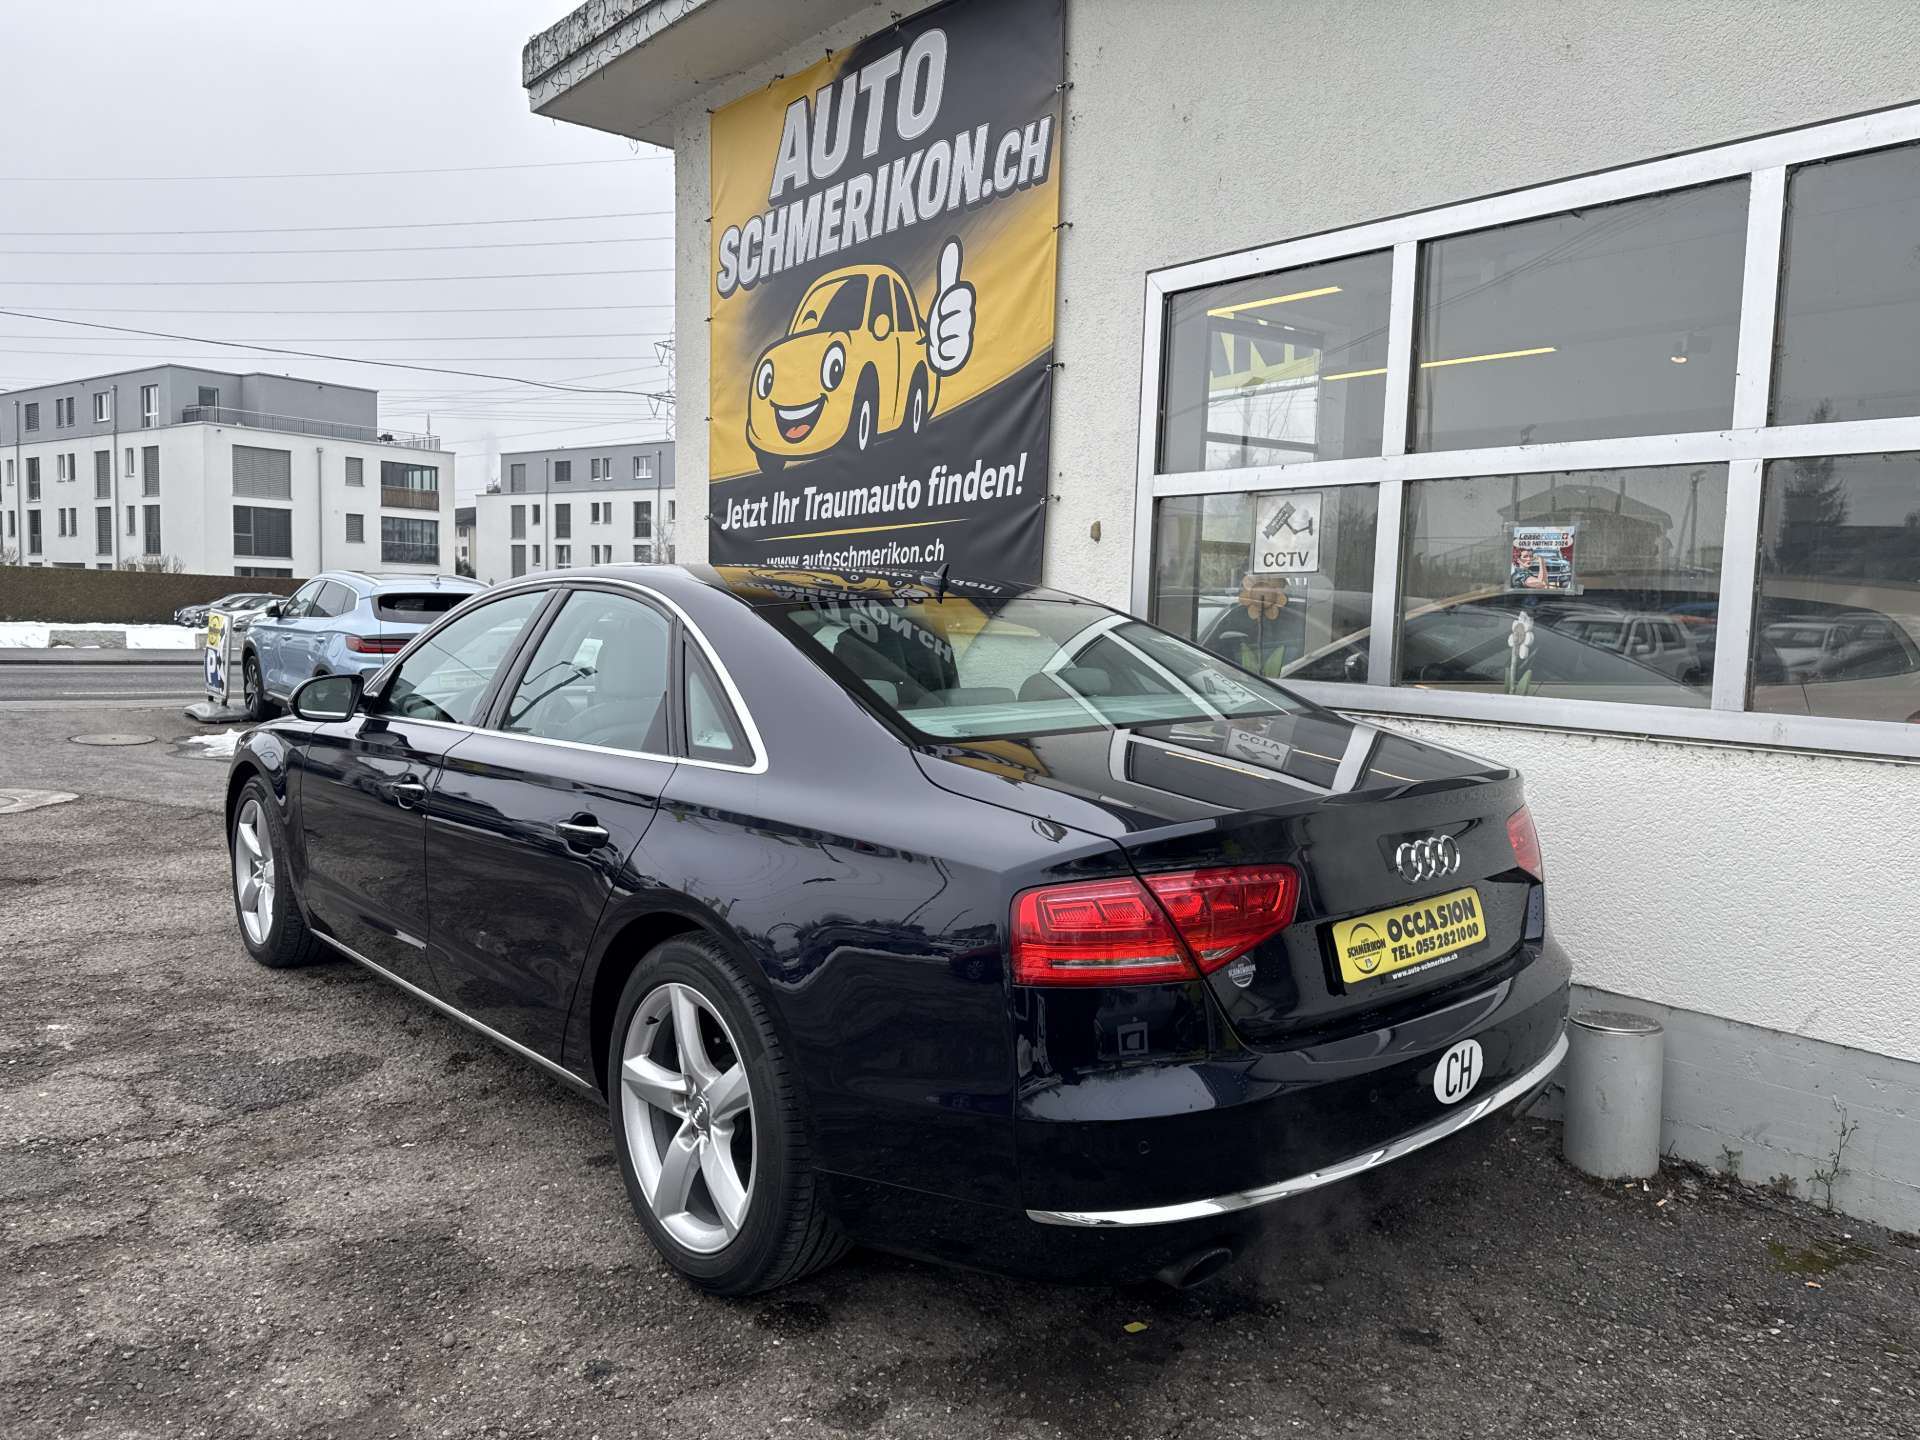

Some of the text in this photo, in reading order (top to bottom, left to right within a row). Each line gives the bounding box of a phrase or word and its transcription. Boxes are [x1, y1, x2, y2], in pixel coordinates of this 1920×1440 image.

[769, 28, 947, 199] AUTO
[717, 117, 1051, 292] SCHMERIKON.CH
[721, 453, 1027, 530] Jetzt Ihr Traumauto finden!
[766, 538, 944, 567] wwwautoschmerikon.ch
[1264, 551, 1309, 567] CCTV
[1387, 896, 1476, 942] OCCASION
[1391, 944, 1415, 962] TEL:
[1445, 1045, 1474, 1098] CH
